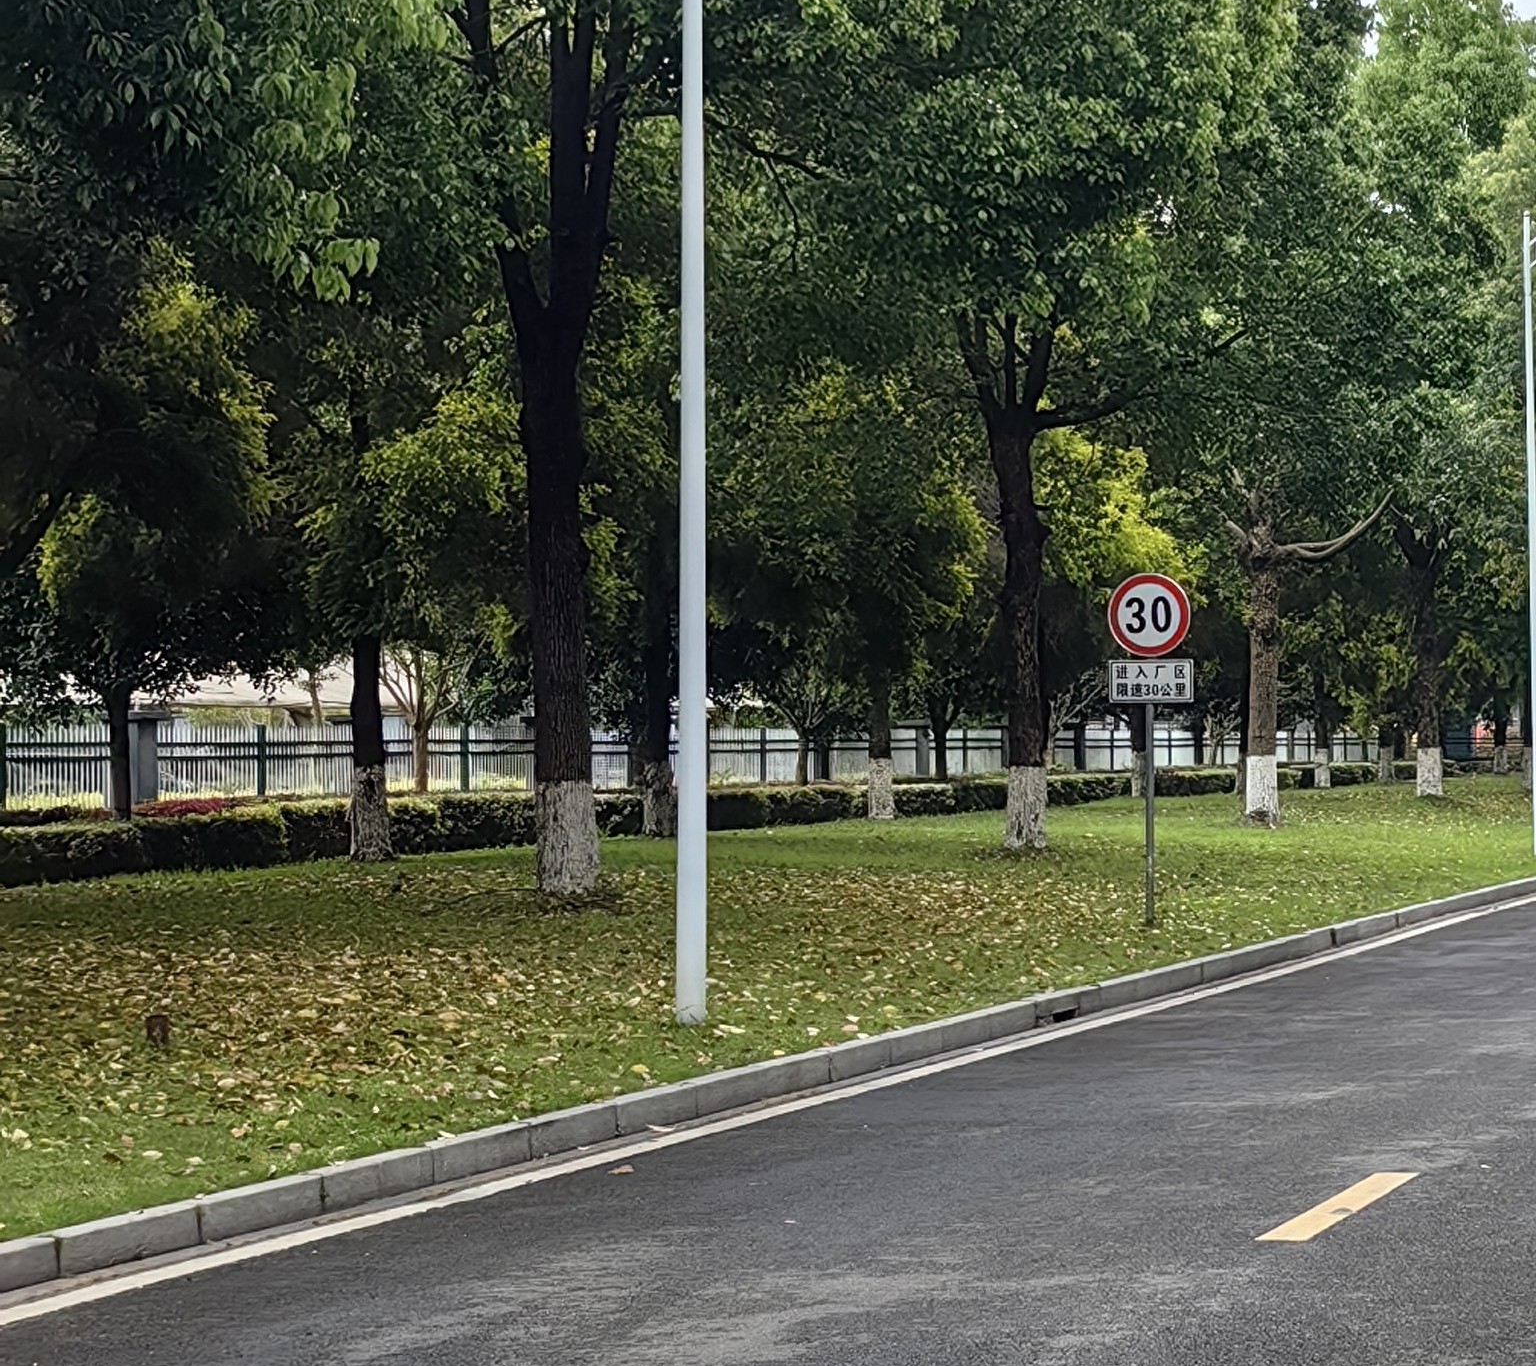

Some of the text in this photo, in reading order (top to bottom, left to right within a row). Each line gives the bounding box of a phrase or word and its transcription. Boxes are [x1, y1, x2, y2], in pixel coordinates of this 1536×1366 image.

[1125, 596, 1172, 633] 30
[1116, 665, 1186, 679] 进入厂区
[1116, 683, 1186, 697] 限速30公里
